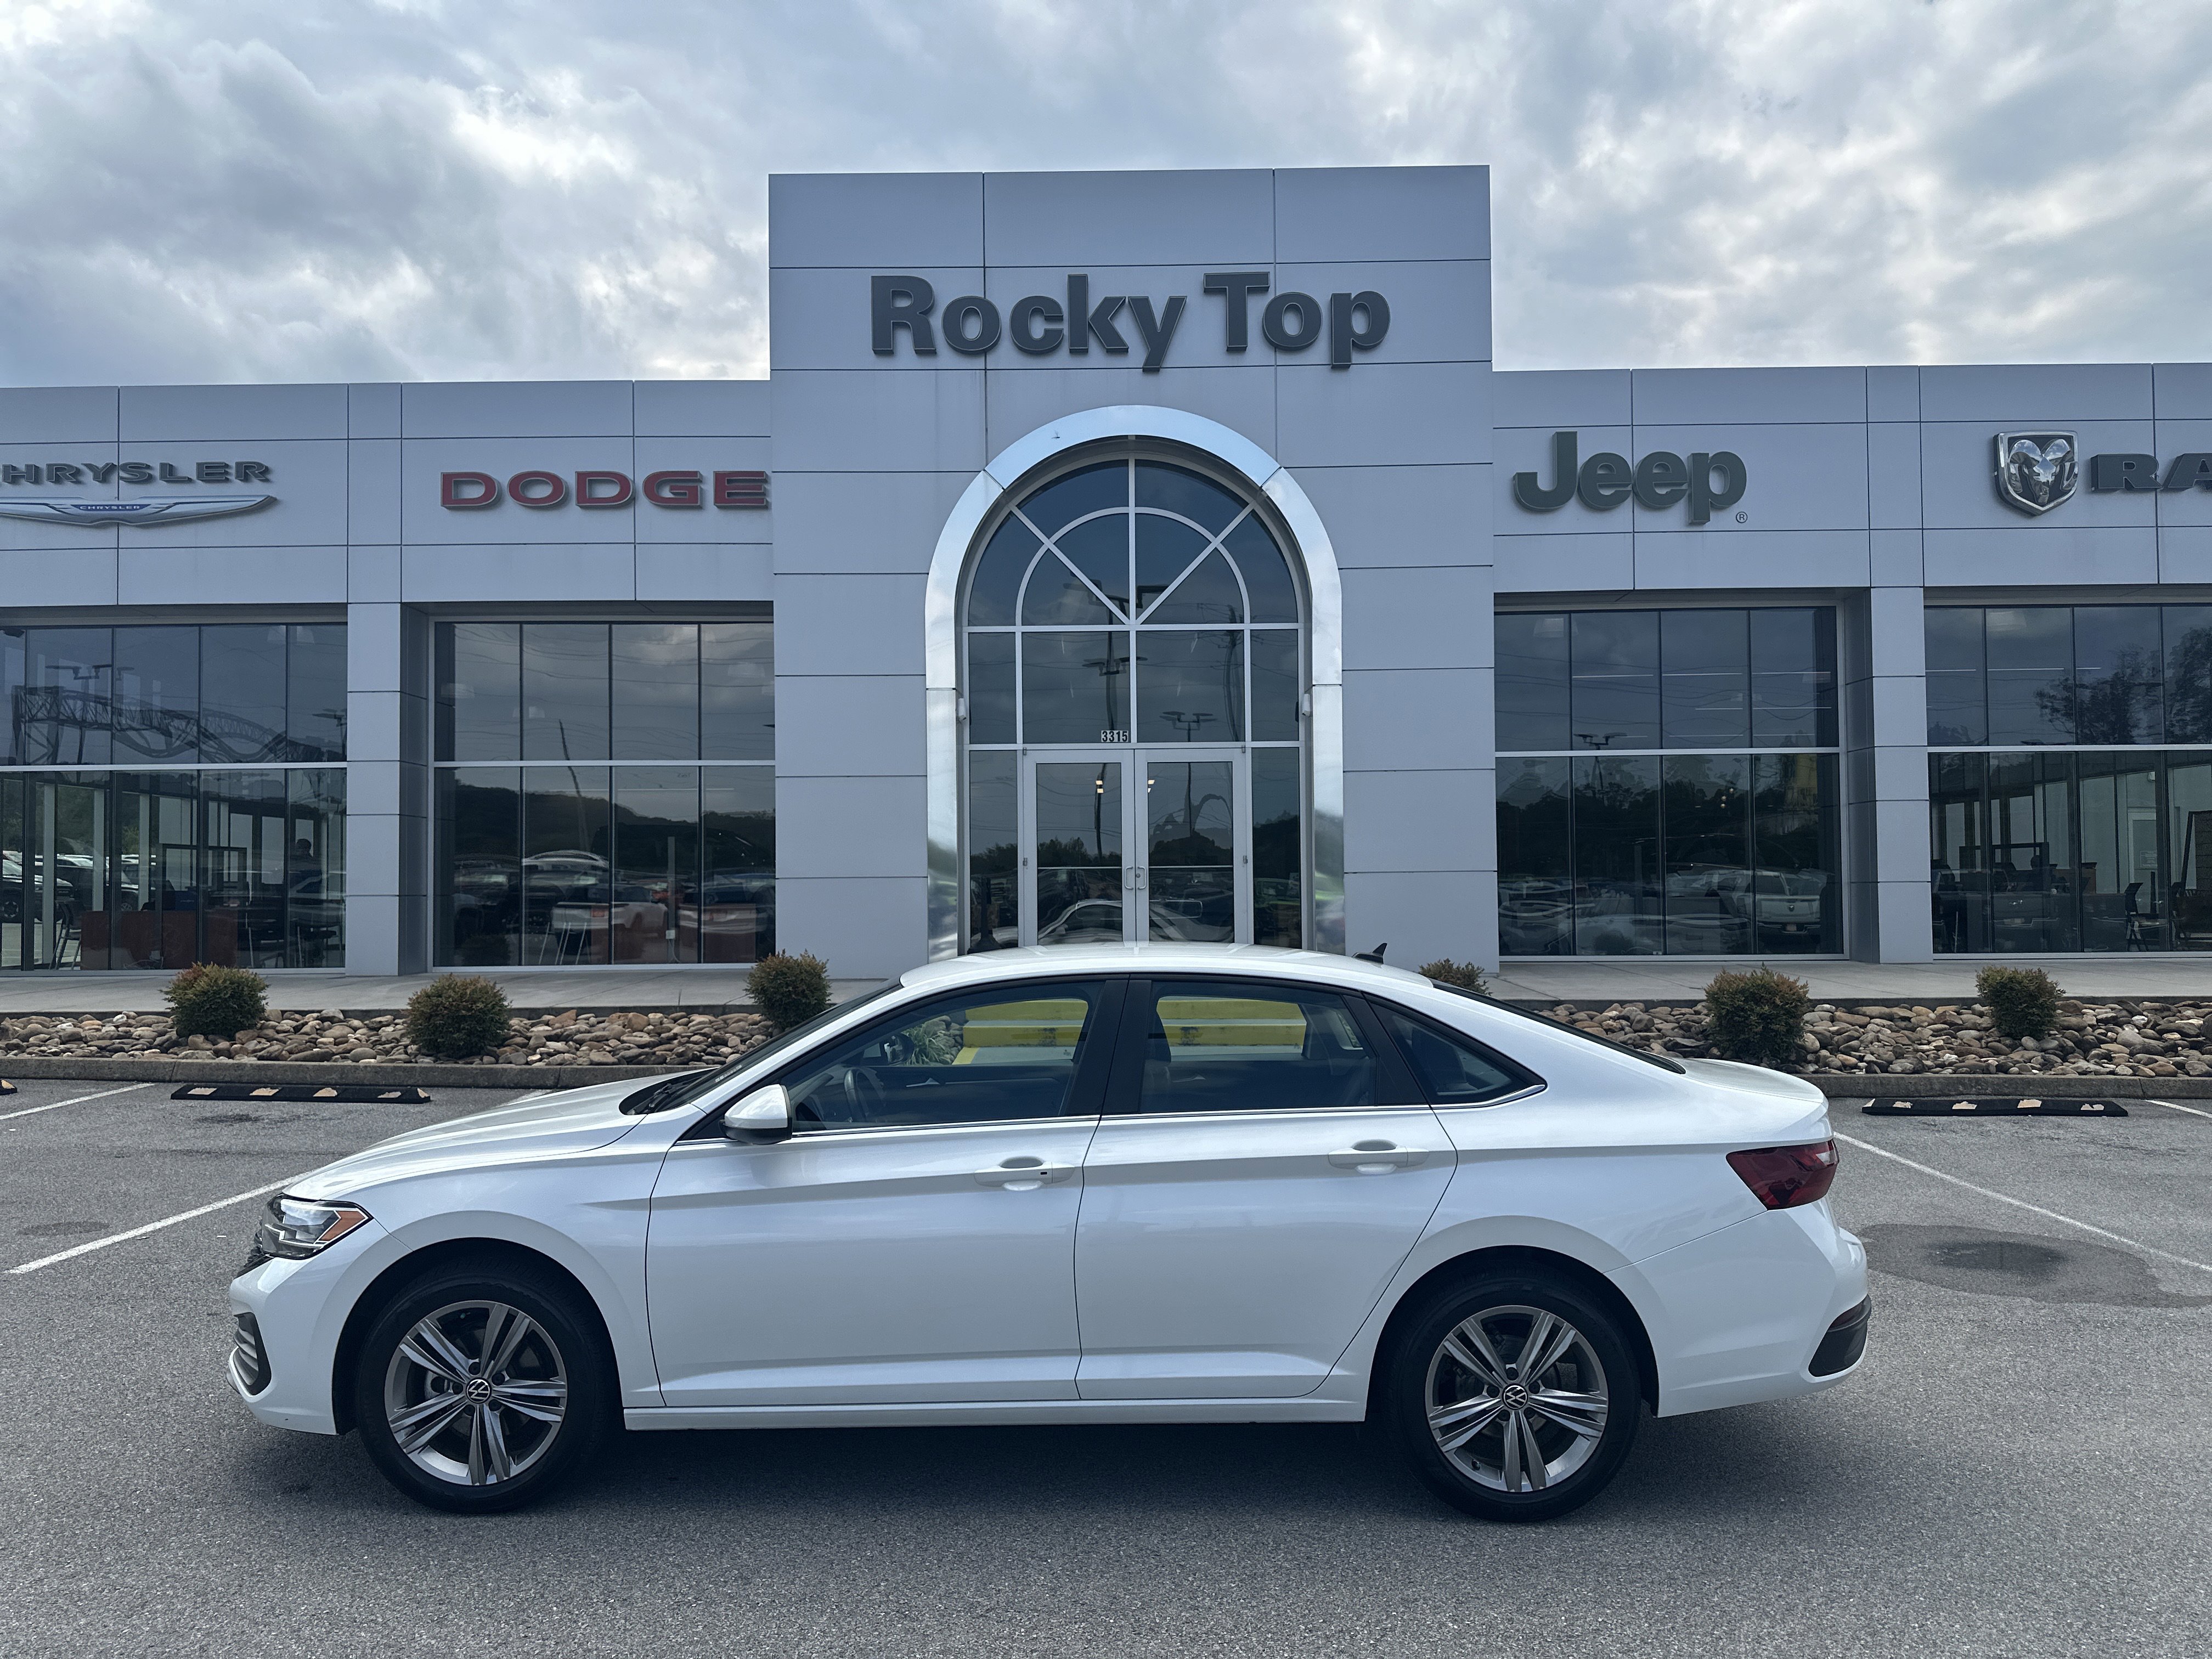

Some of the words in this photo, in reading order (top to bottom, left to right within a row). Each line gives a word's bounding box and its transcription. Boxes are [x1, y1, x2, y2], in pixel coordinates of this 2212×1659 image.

[871, 273, 1187, 372] Rocky
[1203, 271, 1391, 369] Top
[1, 461, 270, 483] HRYSLER
[441, 470, 770, 509] DODGE
[1513, 431, 1747, 525] Jeep
[2091, 453, 2212, 492] RA
[1102, 730, 1128, 742] 3315
